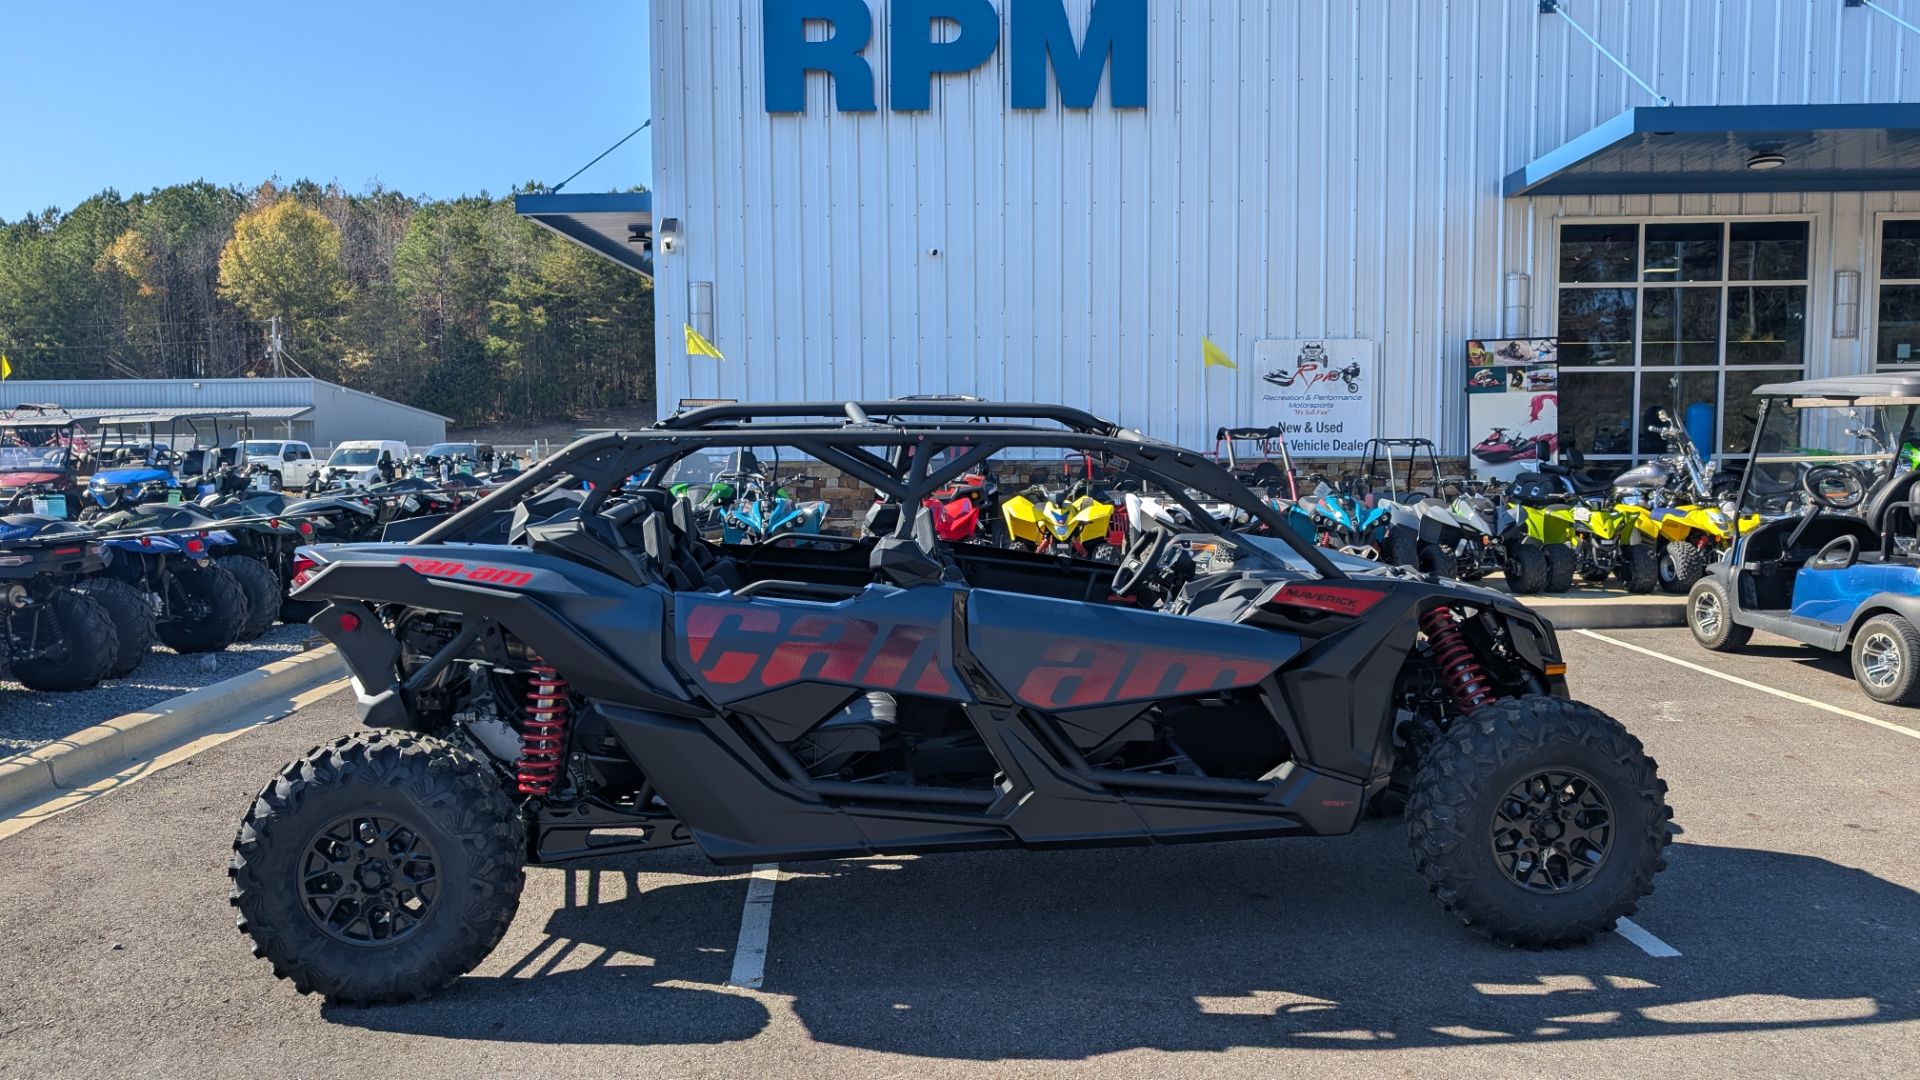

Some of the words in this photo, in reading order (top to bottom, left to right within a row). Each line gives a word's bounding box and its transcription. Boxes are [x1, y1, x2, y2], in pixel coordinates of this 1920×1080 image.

[763, 0, 1149, 113] RPM
[1279, 422, 1302, 433] New
[1304, 422, 1313, 433] &
[1316, 422, 1343, 433] Used
[1256, 439, 1288, 451] Moto
[1291, 440, 1330, 451] Vehicle
[1286, 588, 1359, 607] MAVERICK
